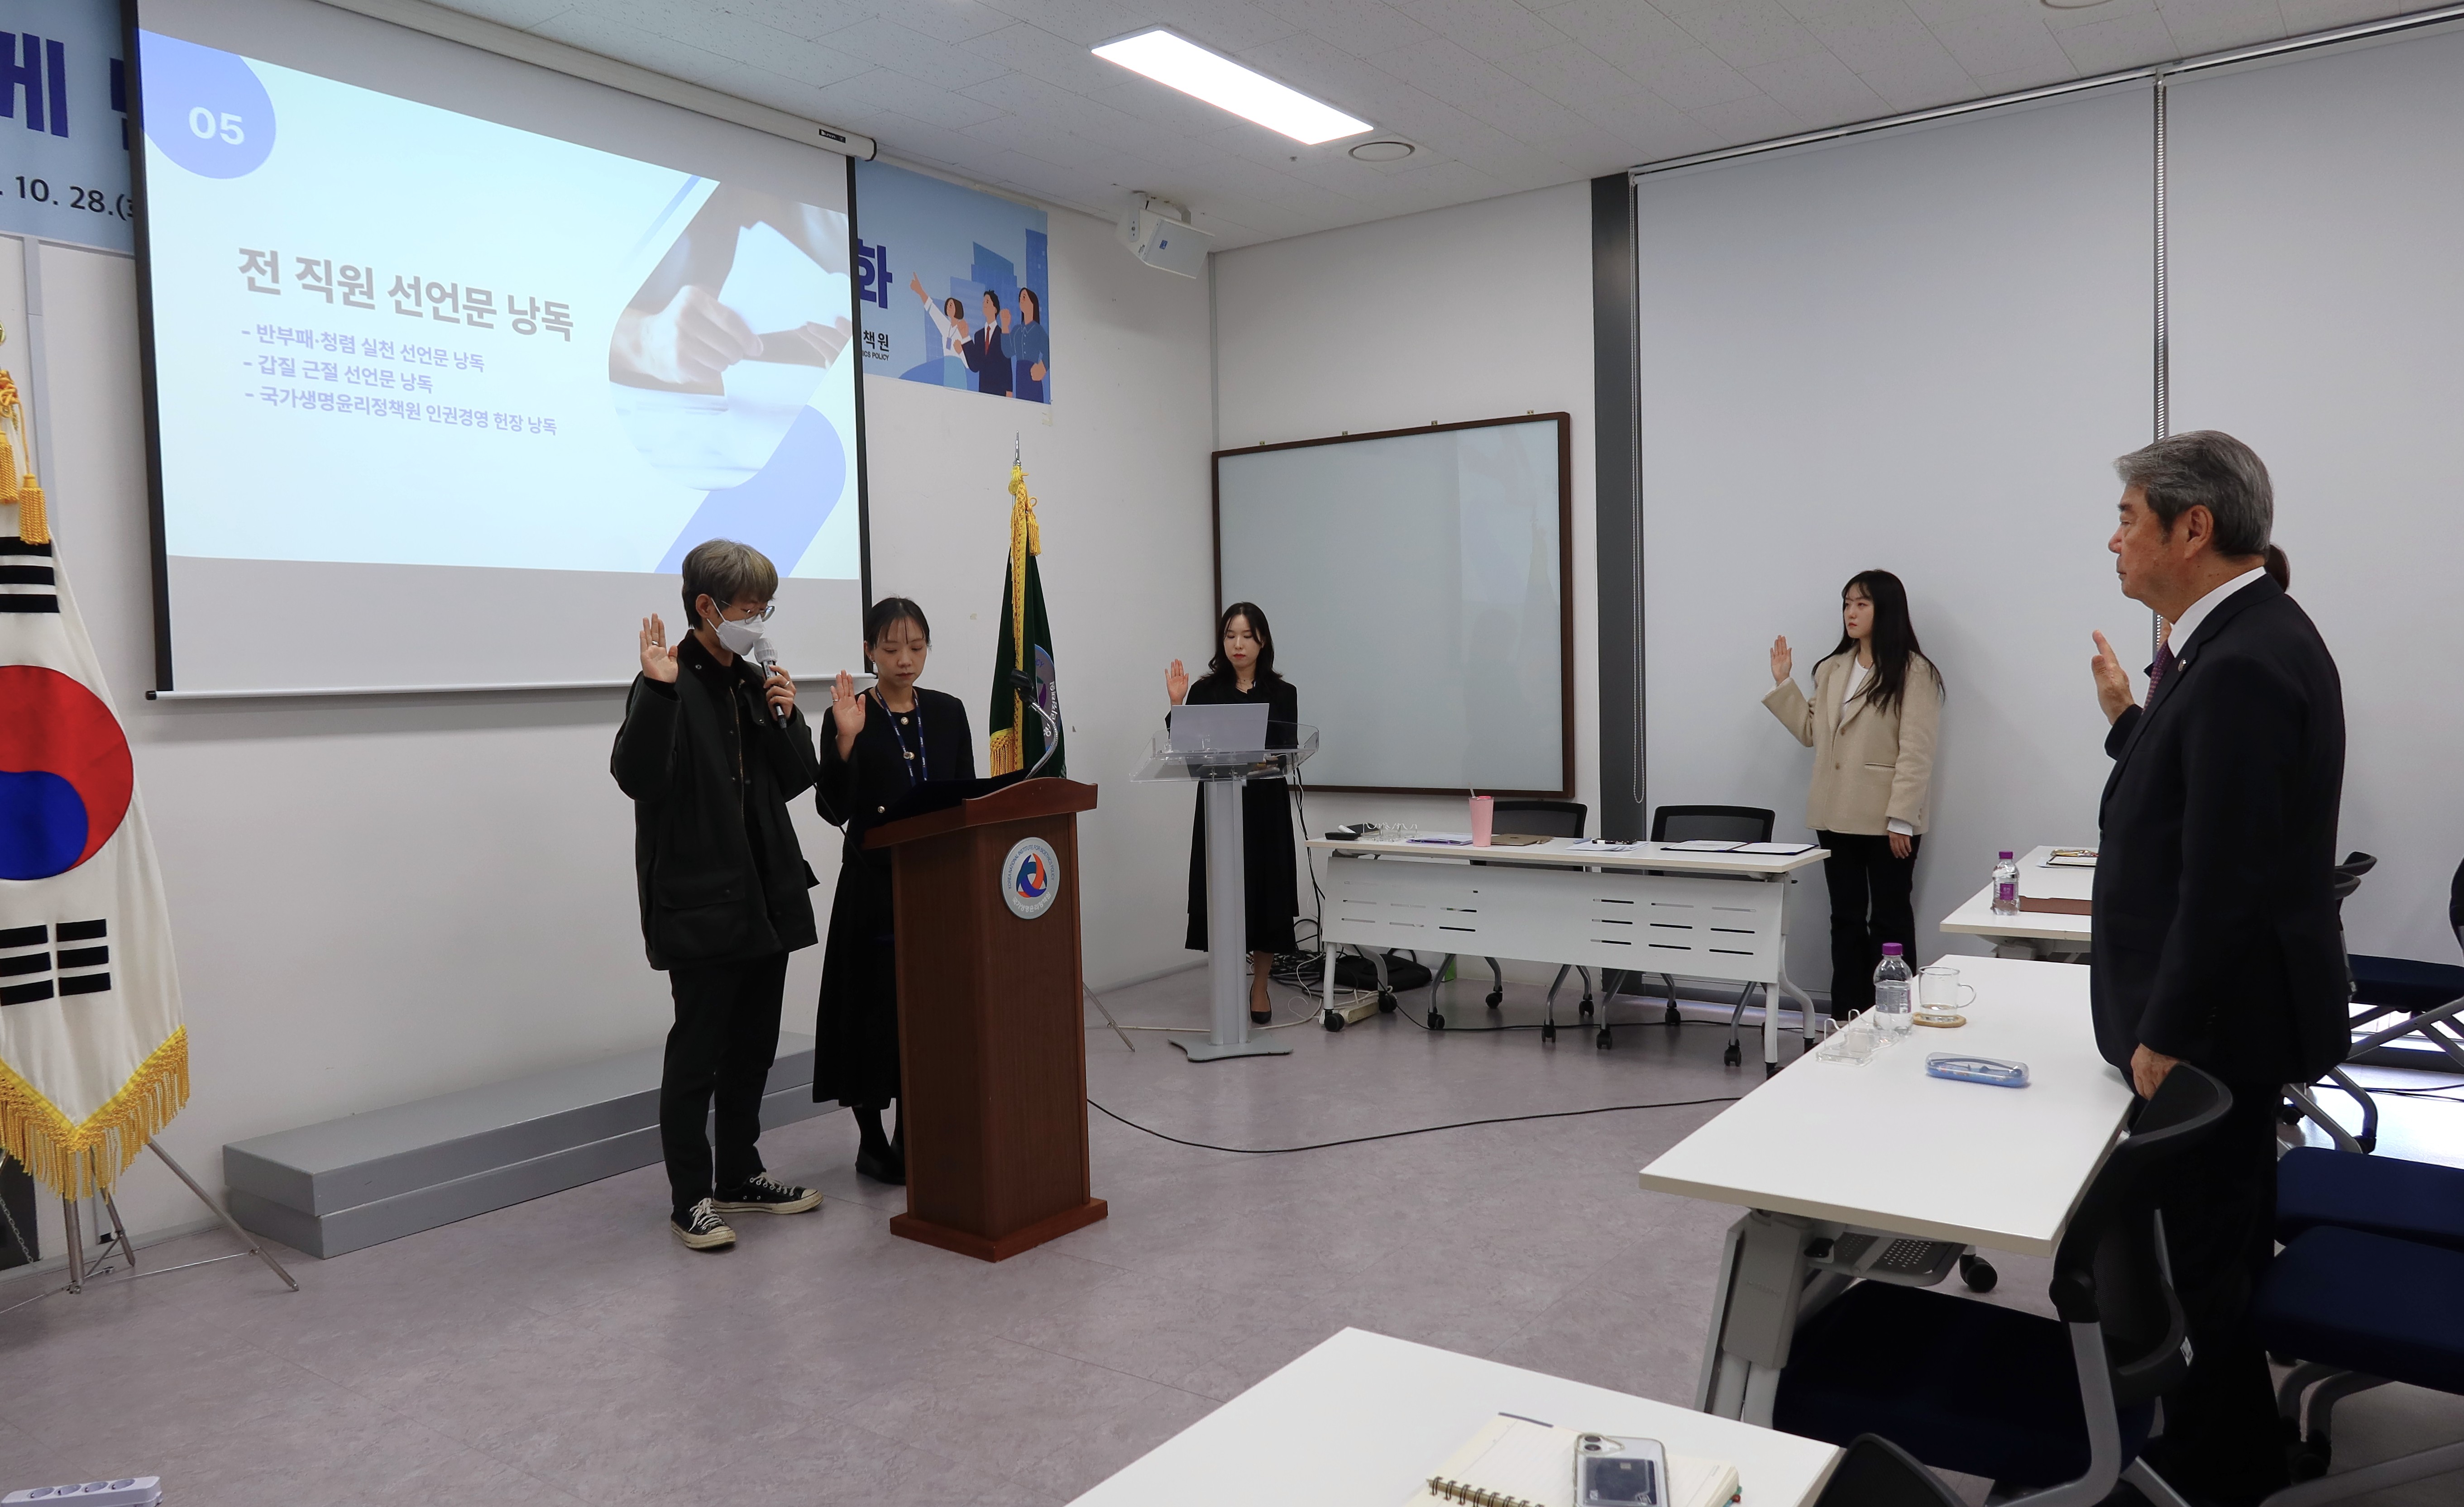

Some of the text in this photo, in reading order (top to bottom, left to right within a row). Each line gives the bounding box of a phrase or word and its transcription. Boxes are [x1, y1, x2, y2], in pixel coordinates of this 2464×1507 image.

[189, 106, 244, 145] 05
[16, 176, 58, 205] 10.
[238, 248, 574, 342] 전 직원 선언문 낭독
[257, 324, 356, 354] 반부패·청렴
[361, 338, 395, 360] 실천
[400, 344, 450, 367] 선언문
[454, 352, 485, 373] 낭독
[872, 352, 889, 361] POLICY
[258, 355, 296, 377] 갑질
[302, 361, 339, 382] 근절
[344, 366, 396, 389] 선언문
[401, 373, 434, 394] 낭독
[260, 386, 421, 421] 국가생명윤리정책원
[426, 405, 489, 429] 인권경영
[493, 412, 524, 432] 헌장
[528, 417, 558, 436] 낭독
[1009, 854, 1019, 873] NATIONAL
[1018, 844, 1033, 855] INSTITUTE
[1040, 848, 1053, 865] BIOETHICS
